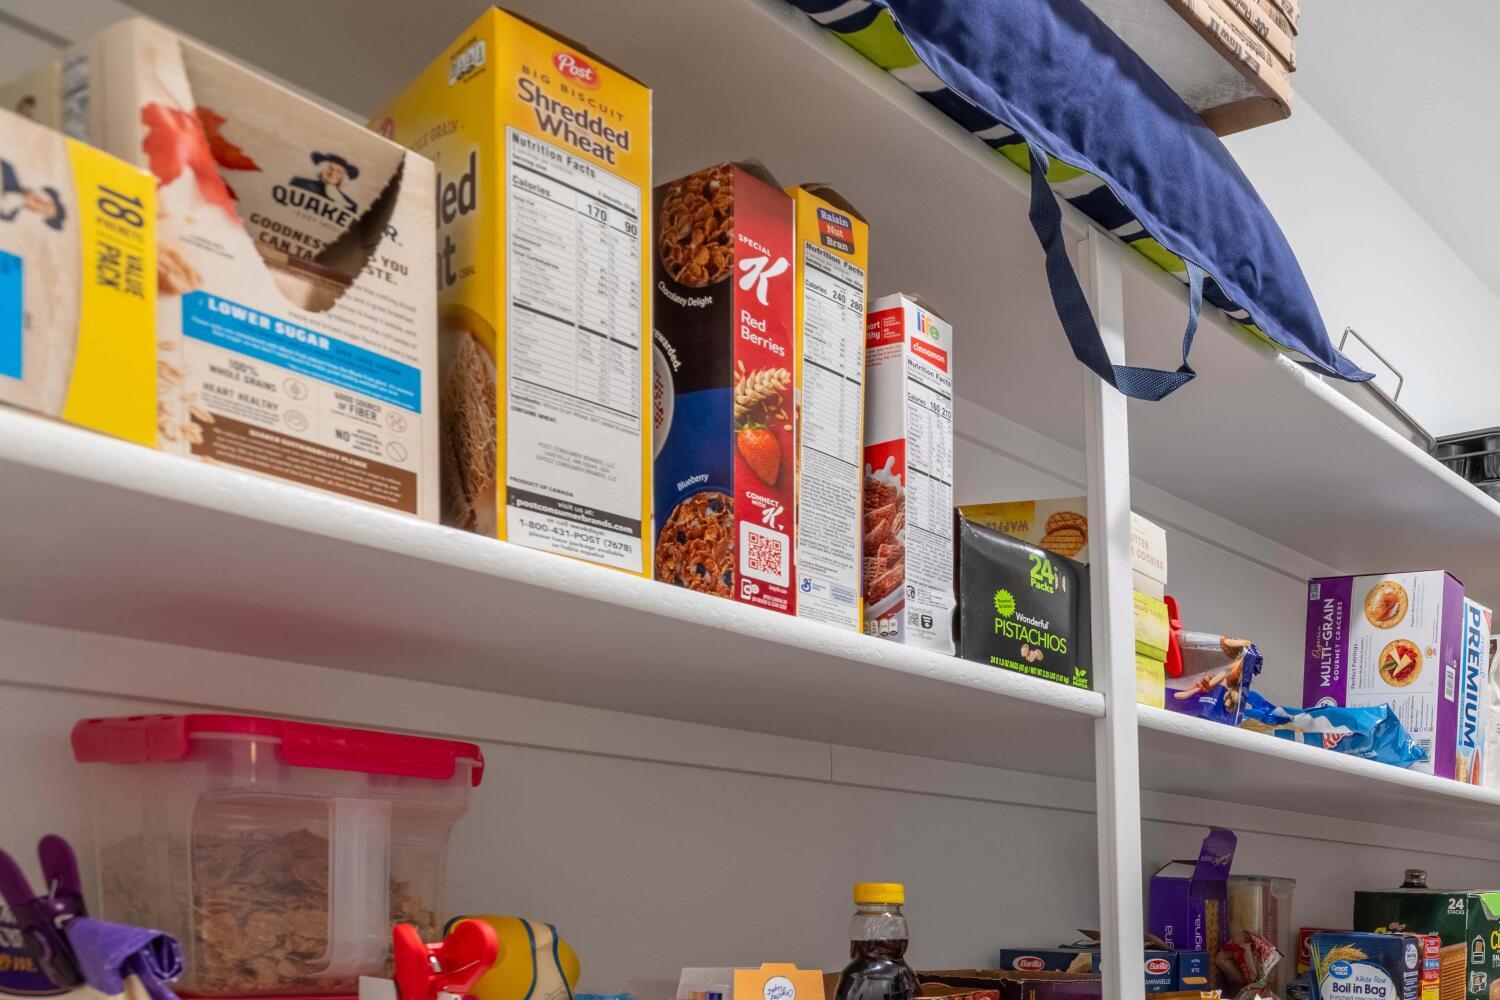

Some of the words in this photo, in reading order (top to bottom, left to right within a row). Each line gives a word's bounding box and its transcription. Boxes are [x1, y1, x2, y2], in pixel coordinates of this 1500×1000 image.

[558, 53, 593, 81] Post
[522, 65, 550, 85] BIG
[560, 84, 624, 122] BISCUIT
[518, 77, 629, 151] Shredded
[535, 107, 615, 165] Wheat
[512, 133, 562, 161] Nutrition
[567, 158, 596, 178] Facts
[512, 176, 550, 196] Calories
[97, 186, 143, 230] 18
[586, 203, 608, 222] 170
[624, 220, 638, 236] 90
[821, 210, 849, 228] Raisin
[827, 224, 844, 238] Nut
[738, 234, 771, 257] SPECIAL
[826, 236, 849, 252] Bran
[383, 256, 408, 276] YOU
[806, 243, 841, 265] Nutrition
[844, 262, 864, 277] Facts
[738, 256, 790, 306] K
[687, 295, 713, 308] Delight
[832, 291, 846, 304] 240
[850, 299, 864, 312] 280
[208, 298, 274, 331] LOWER
[277, 319, 330, 351] SUGAR
[741, 309, 766, 333] Red
[917, 311, 939, 340] life
[741, 328, 785, 357] Berries
[912, 342, 945, 363] cinnamon
[908, 359, 934, 379] Nutrition
[677, 474, 709, 491] Blueberry
[745, 491, 779, 506] CONNECT
[516, 499, 633, 533] postconsumerbrands.com
[519, 519, 601, 544] 1-800-431-POST
[1029, 553, 1054, 584] 24
[1030, 578, 1054, 593] Packs
[1015, 612, 1049, 630] Wonderful
[995, 618, 1067, 654] PISTACHIOS
[1320, 598, 1335, 687] MULTI-GRAIN
[1464, 605, 1481, 749] PREMIUM
[1448, 898, 1464, 910] 24
[1020, 959, 1042, 968] Barilla
[1149, 962, 1168, 970] Barilla
[1331, 965, 1348, 973] Great
[1332, 982, 1350, 993] Boil
[1353, 983, 1362, 994] in
[1364, 984, 1386, 997] Bag
